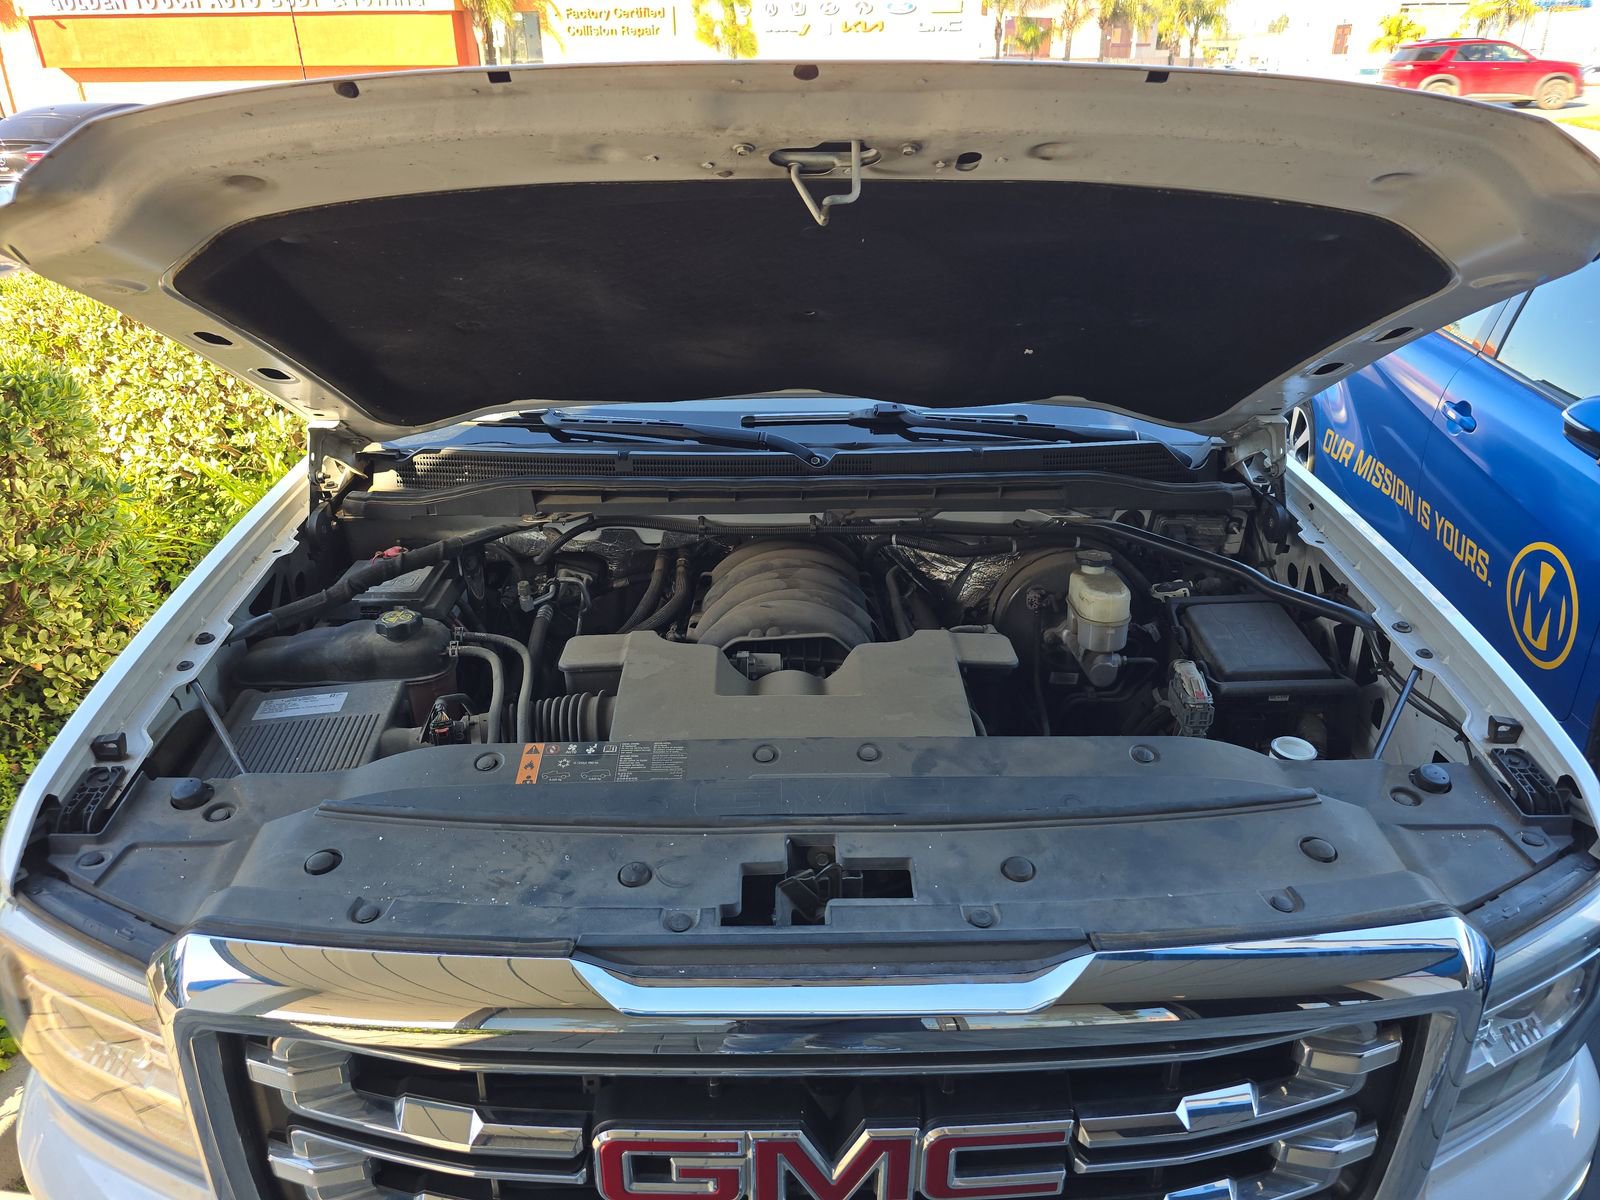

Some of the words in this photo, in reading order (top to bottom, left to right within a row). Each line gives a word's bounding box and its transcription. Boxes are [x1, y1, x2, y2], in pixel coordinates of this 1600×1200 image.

[565, 8, 610, 21] Factory
[614, 7, 665, 18] Certified
[567, 25, 617, 36] Collision
[621, 24, 660, 37] Repair
[1322, 428, 1355, 467] OUR
[1353, 450, 1415, 516] MISSION
[1417, 496, 1431, 530] IS
[1434, 510, 1492, 588] YOURS.
[593, 1120, 1075, 1200] GMC
